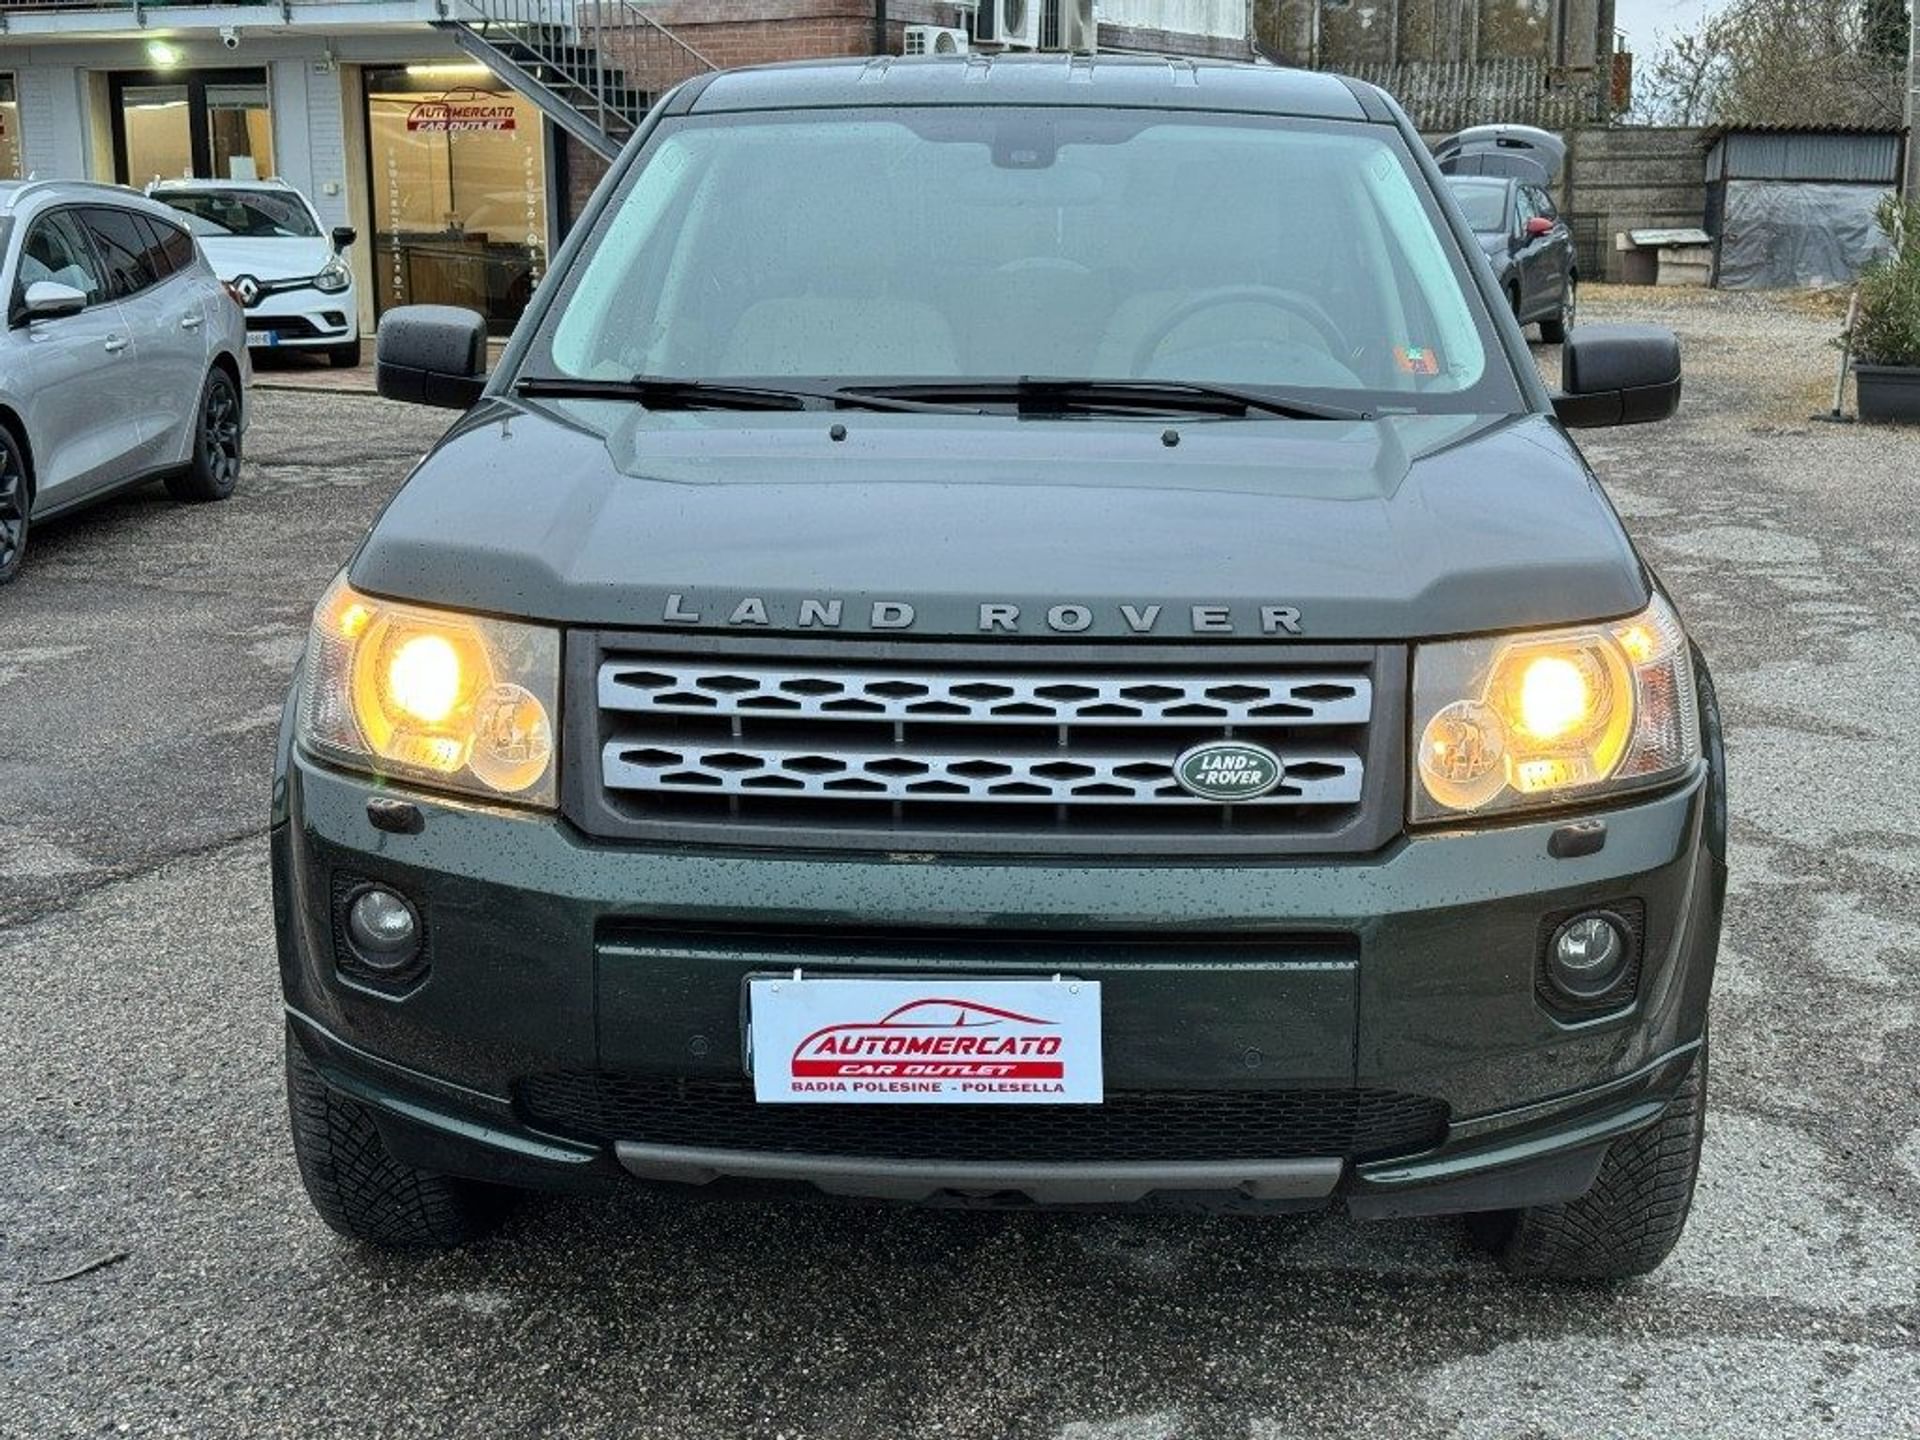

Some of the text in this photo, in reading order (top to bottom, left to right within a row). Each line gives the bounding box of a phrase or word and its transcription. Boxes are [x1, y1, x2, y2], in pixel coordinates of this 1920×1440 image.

[416, 106, 515, 118] AUTOMERCATO
[416, 121, 504, 131] CAR OUTLET
[663, 594, 1302, 633] LAND ROVER
[1201, 755, 1247, 770] LAND
[1205, 770, 1262, 784] ROVER
[813, 1036, 1063, 1056] AUTOMERCATO
[838, 1064, 1017, 1076] CAR OUTLET
[792, 1082, 847, 1093] BADIA
[853, 1082, 942, 1093] POLESINE
[962, 1083, 1065, 1093] POLESELLA
